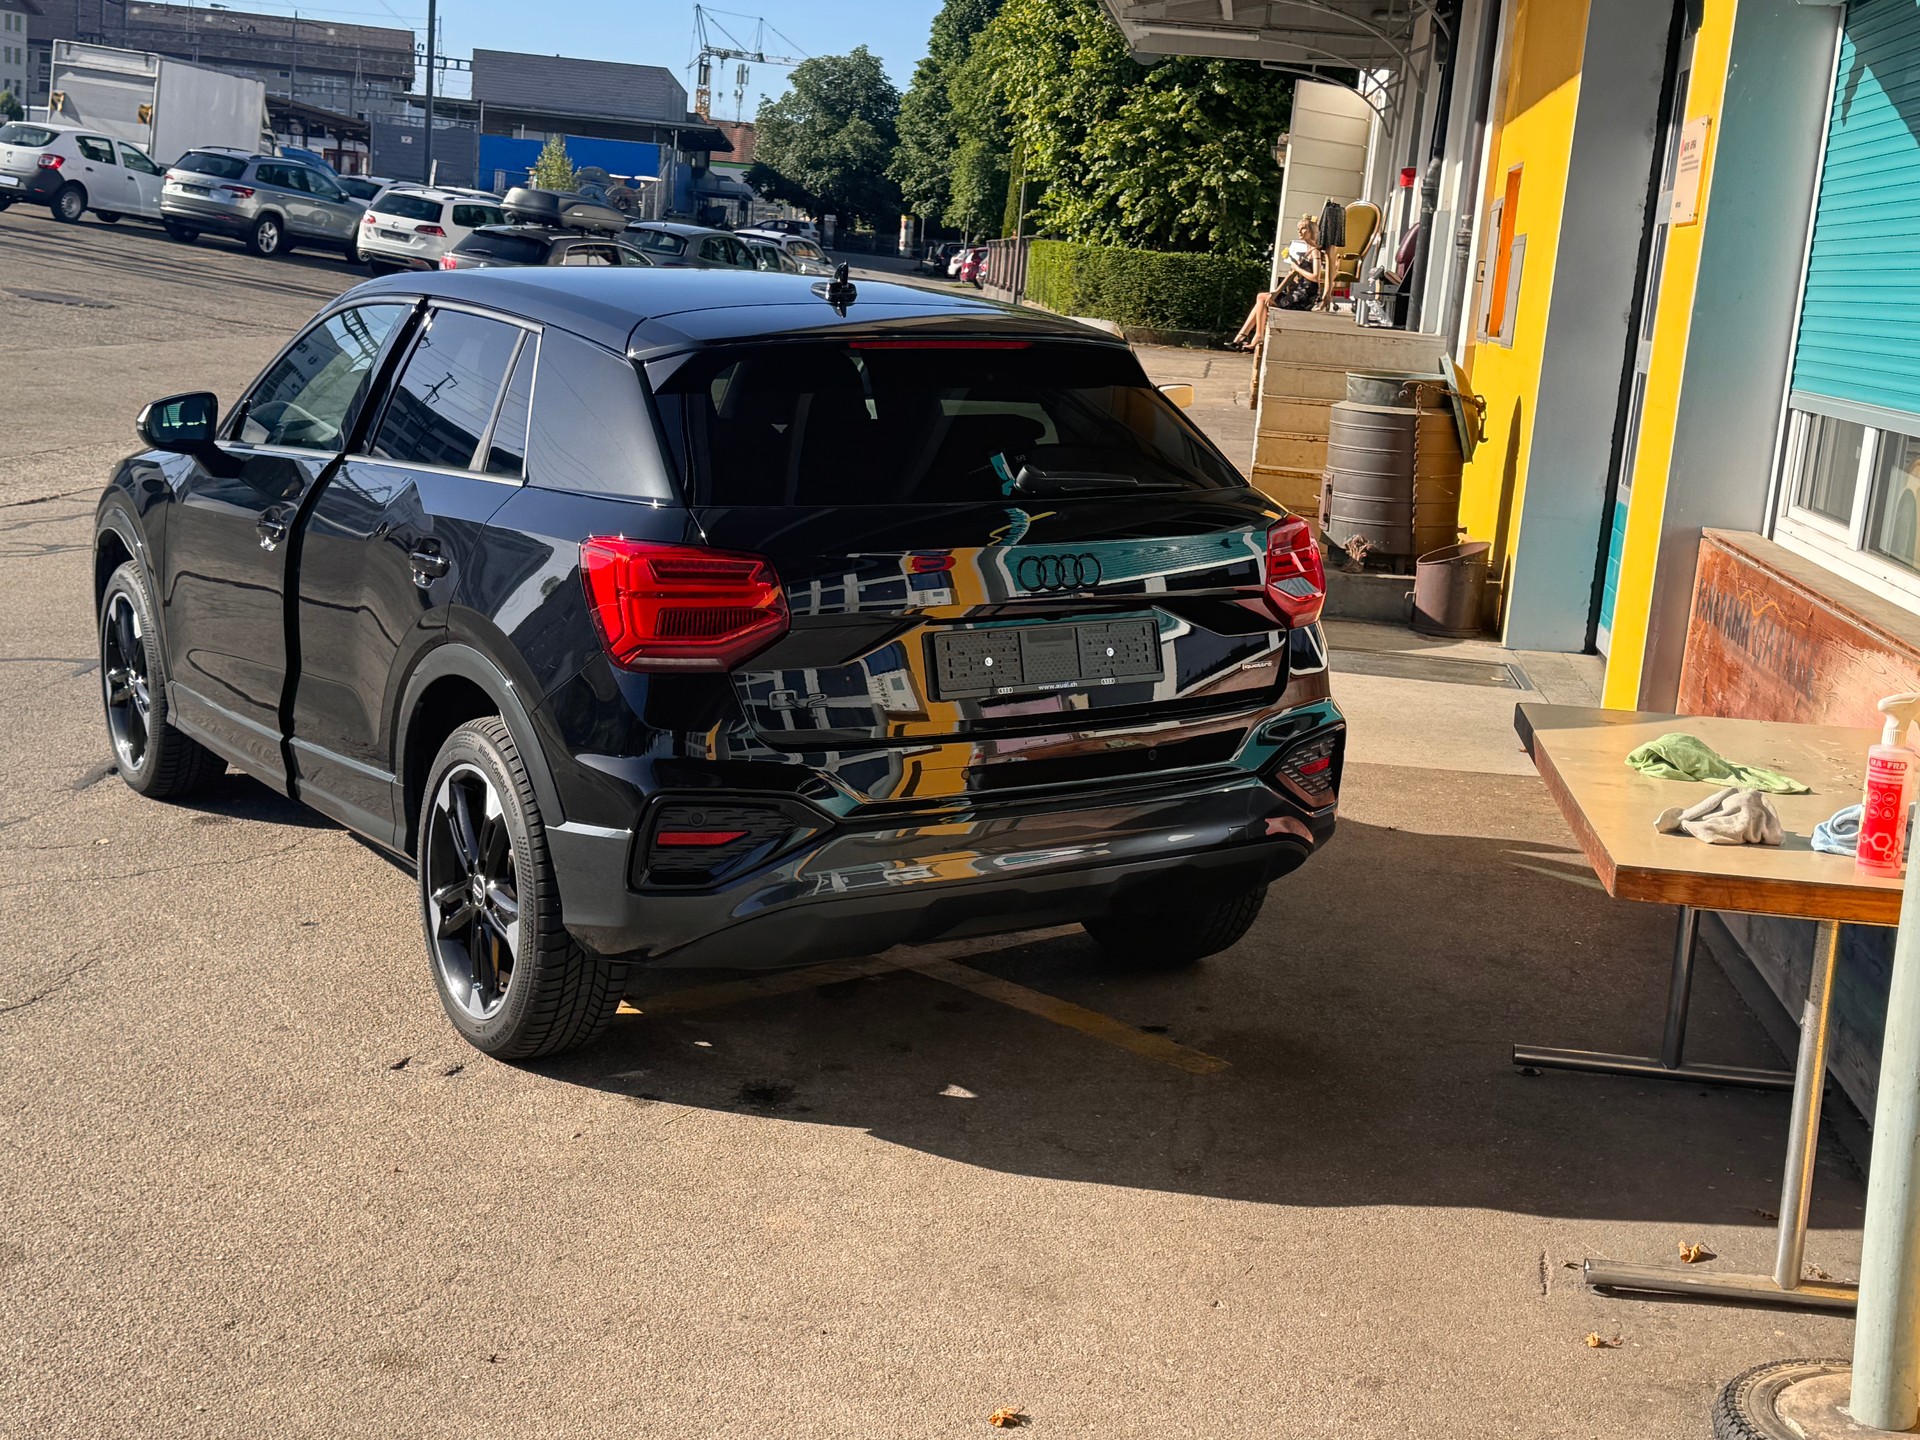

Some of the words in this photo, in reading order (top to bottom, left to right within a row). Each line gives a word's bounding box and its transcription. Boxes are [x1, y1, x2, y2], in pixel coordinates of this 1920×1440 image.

[1038, 681, 1078, 691] www.audi.ch
[769, 689, 828, 711] Q2
[478, 743, 510, 795] WinterContact
